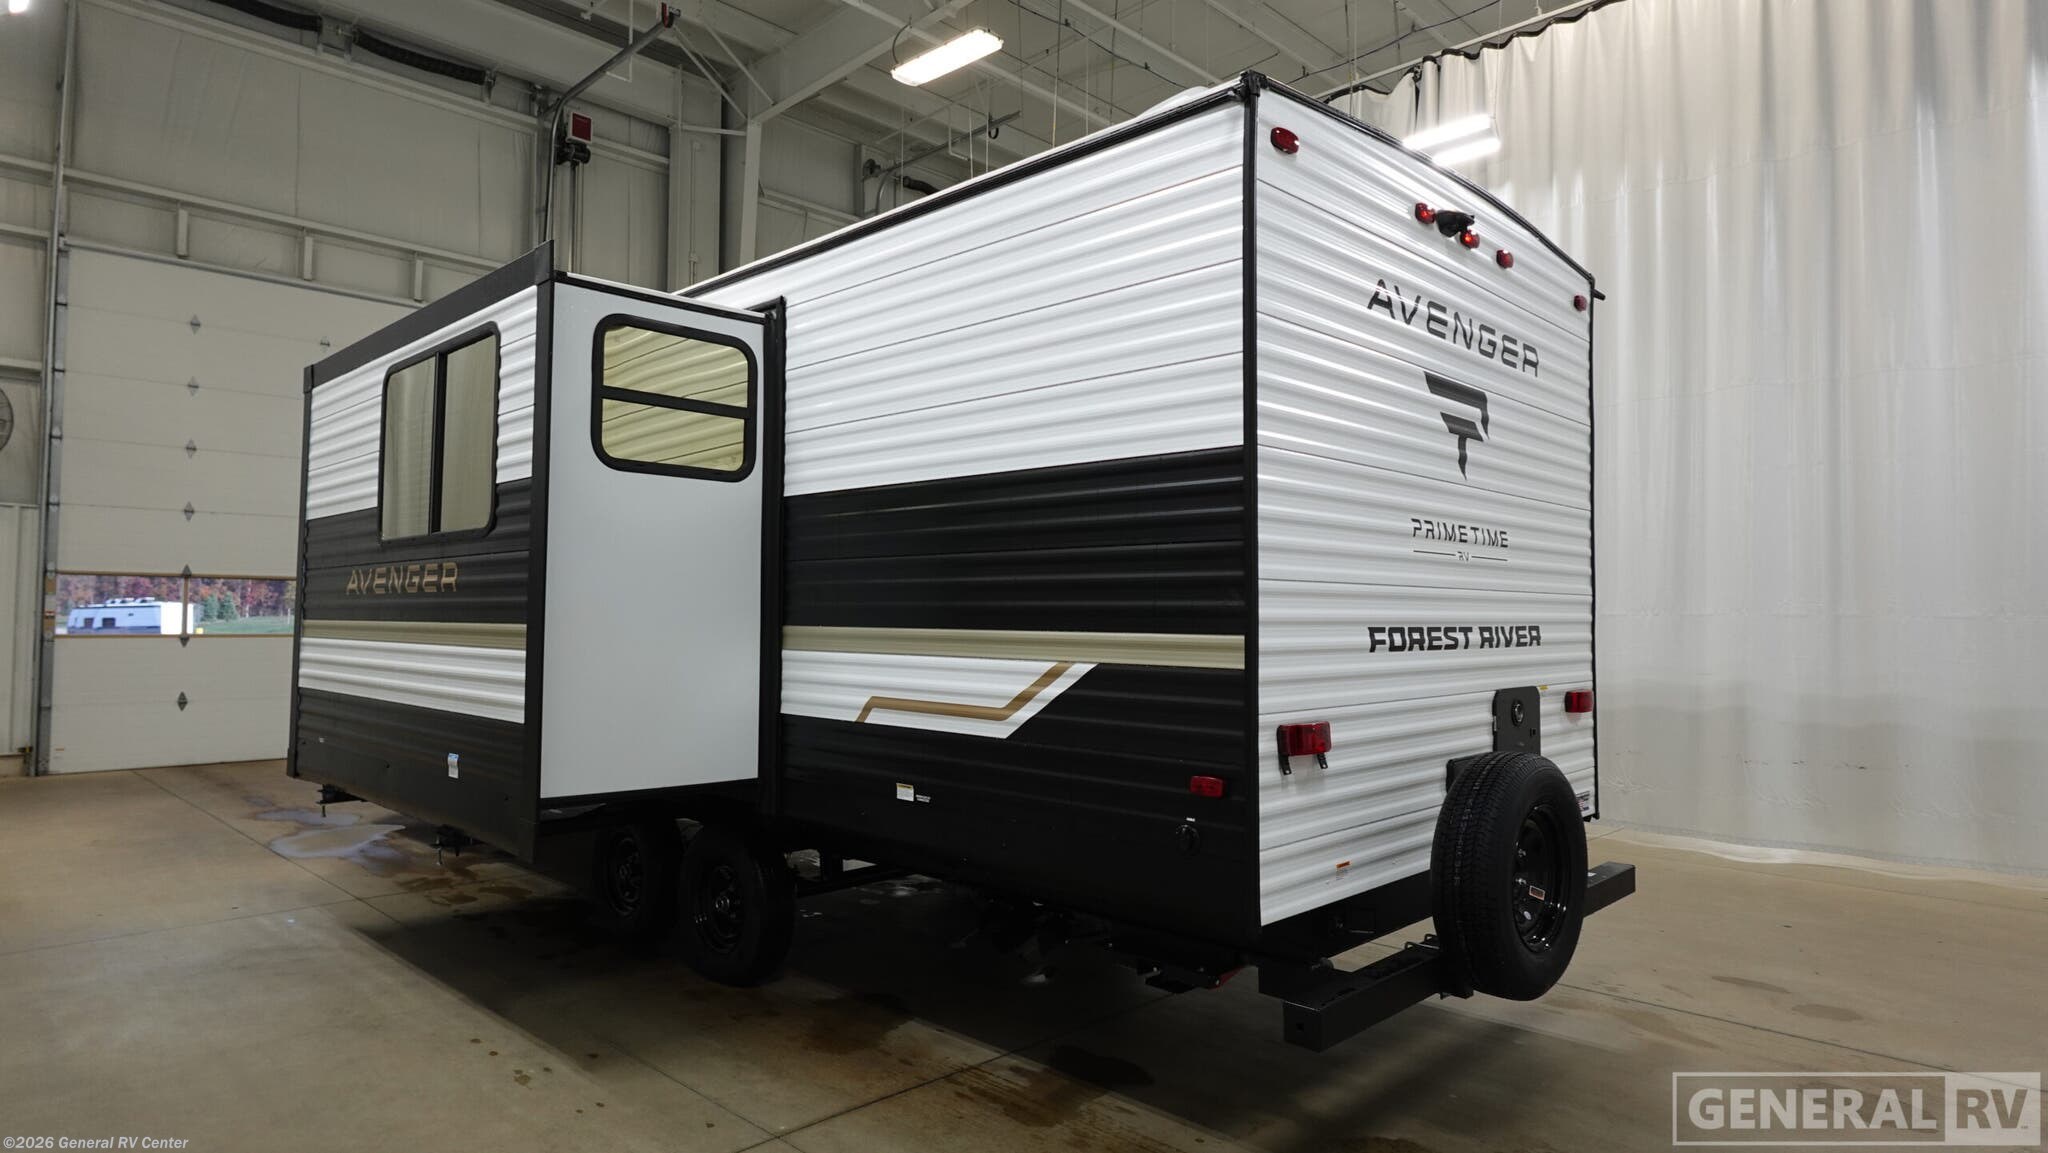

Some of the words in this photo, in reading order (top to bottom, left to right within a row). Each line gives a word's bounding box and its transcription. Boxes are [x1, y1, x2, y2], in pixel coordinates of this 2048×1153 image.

[1367, 278, 1540, 378] AVENGER
[1410, 518, 1509, 548] PRIMETIME
[1457, 551, 1470, 561] RV
[345, 562, 459, 596] AVENGER
[1367, 626, 1474, 653] FOREST
[1478, 625, 1542, 649] RIVER
